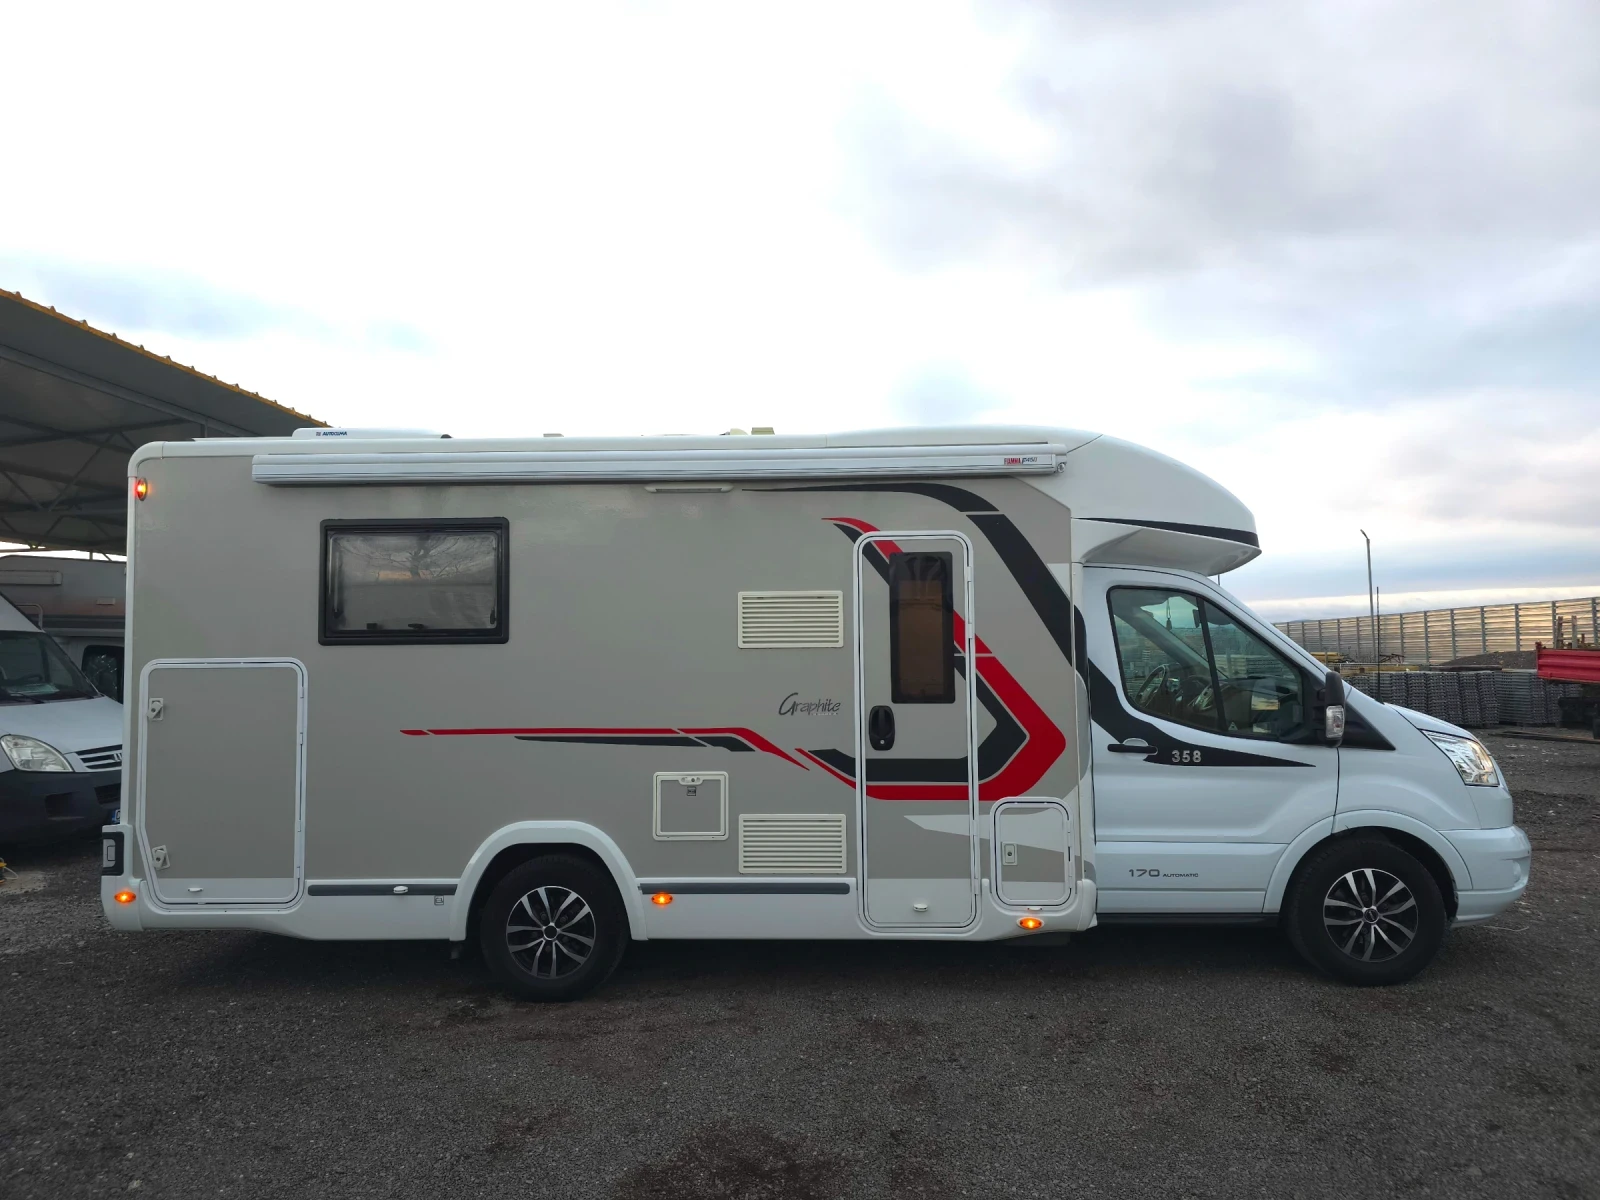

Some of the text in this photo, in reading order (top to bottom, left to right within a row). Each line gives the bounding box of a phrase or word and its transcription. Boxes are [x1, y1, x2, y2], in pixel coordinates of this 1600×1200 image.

[778, 692, 842, 716] Graphite
[1171, 749, 1202, 763] 358
[1128, 868, 1161, 878] 170
